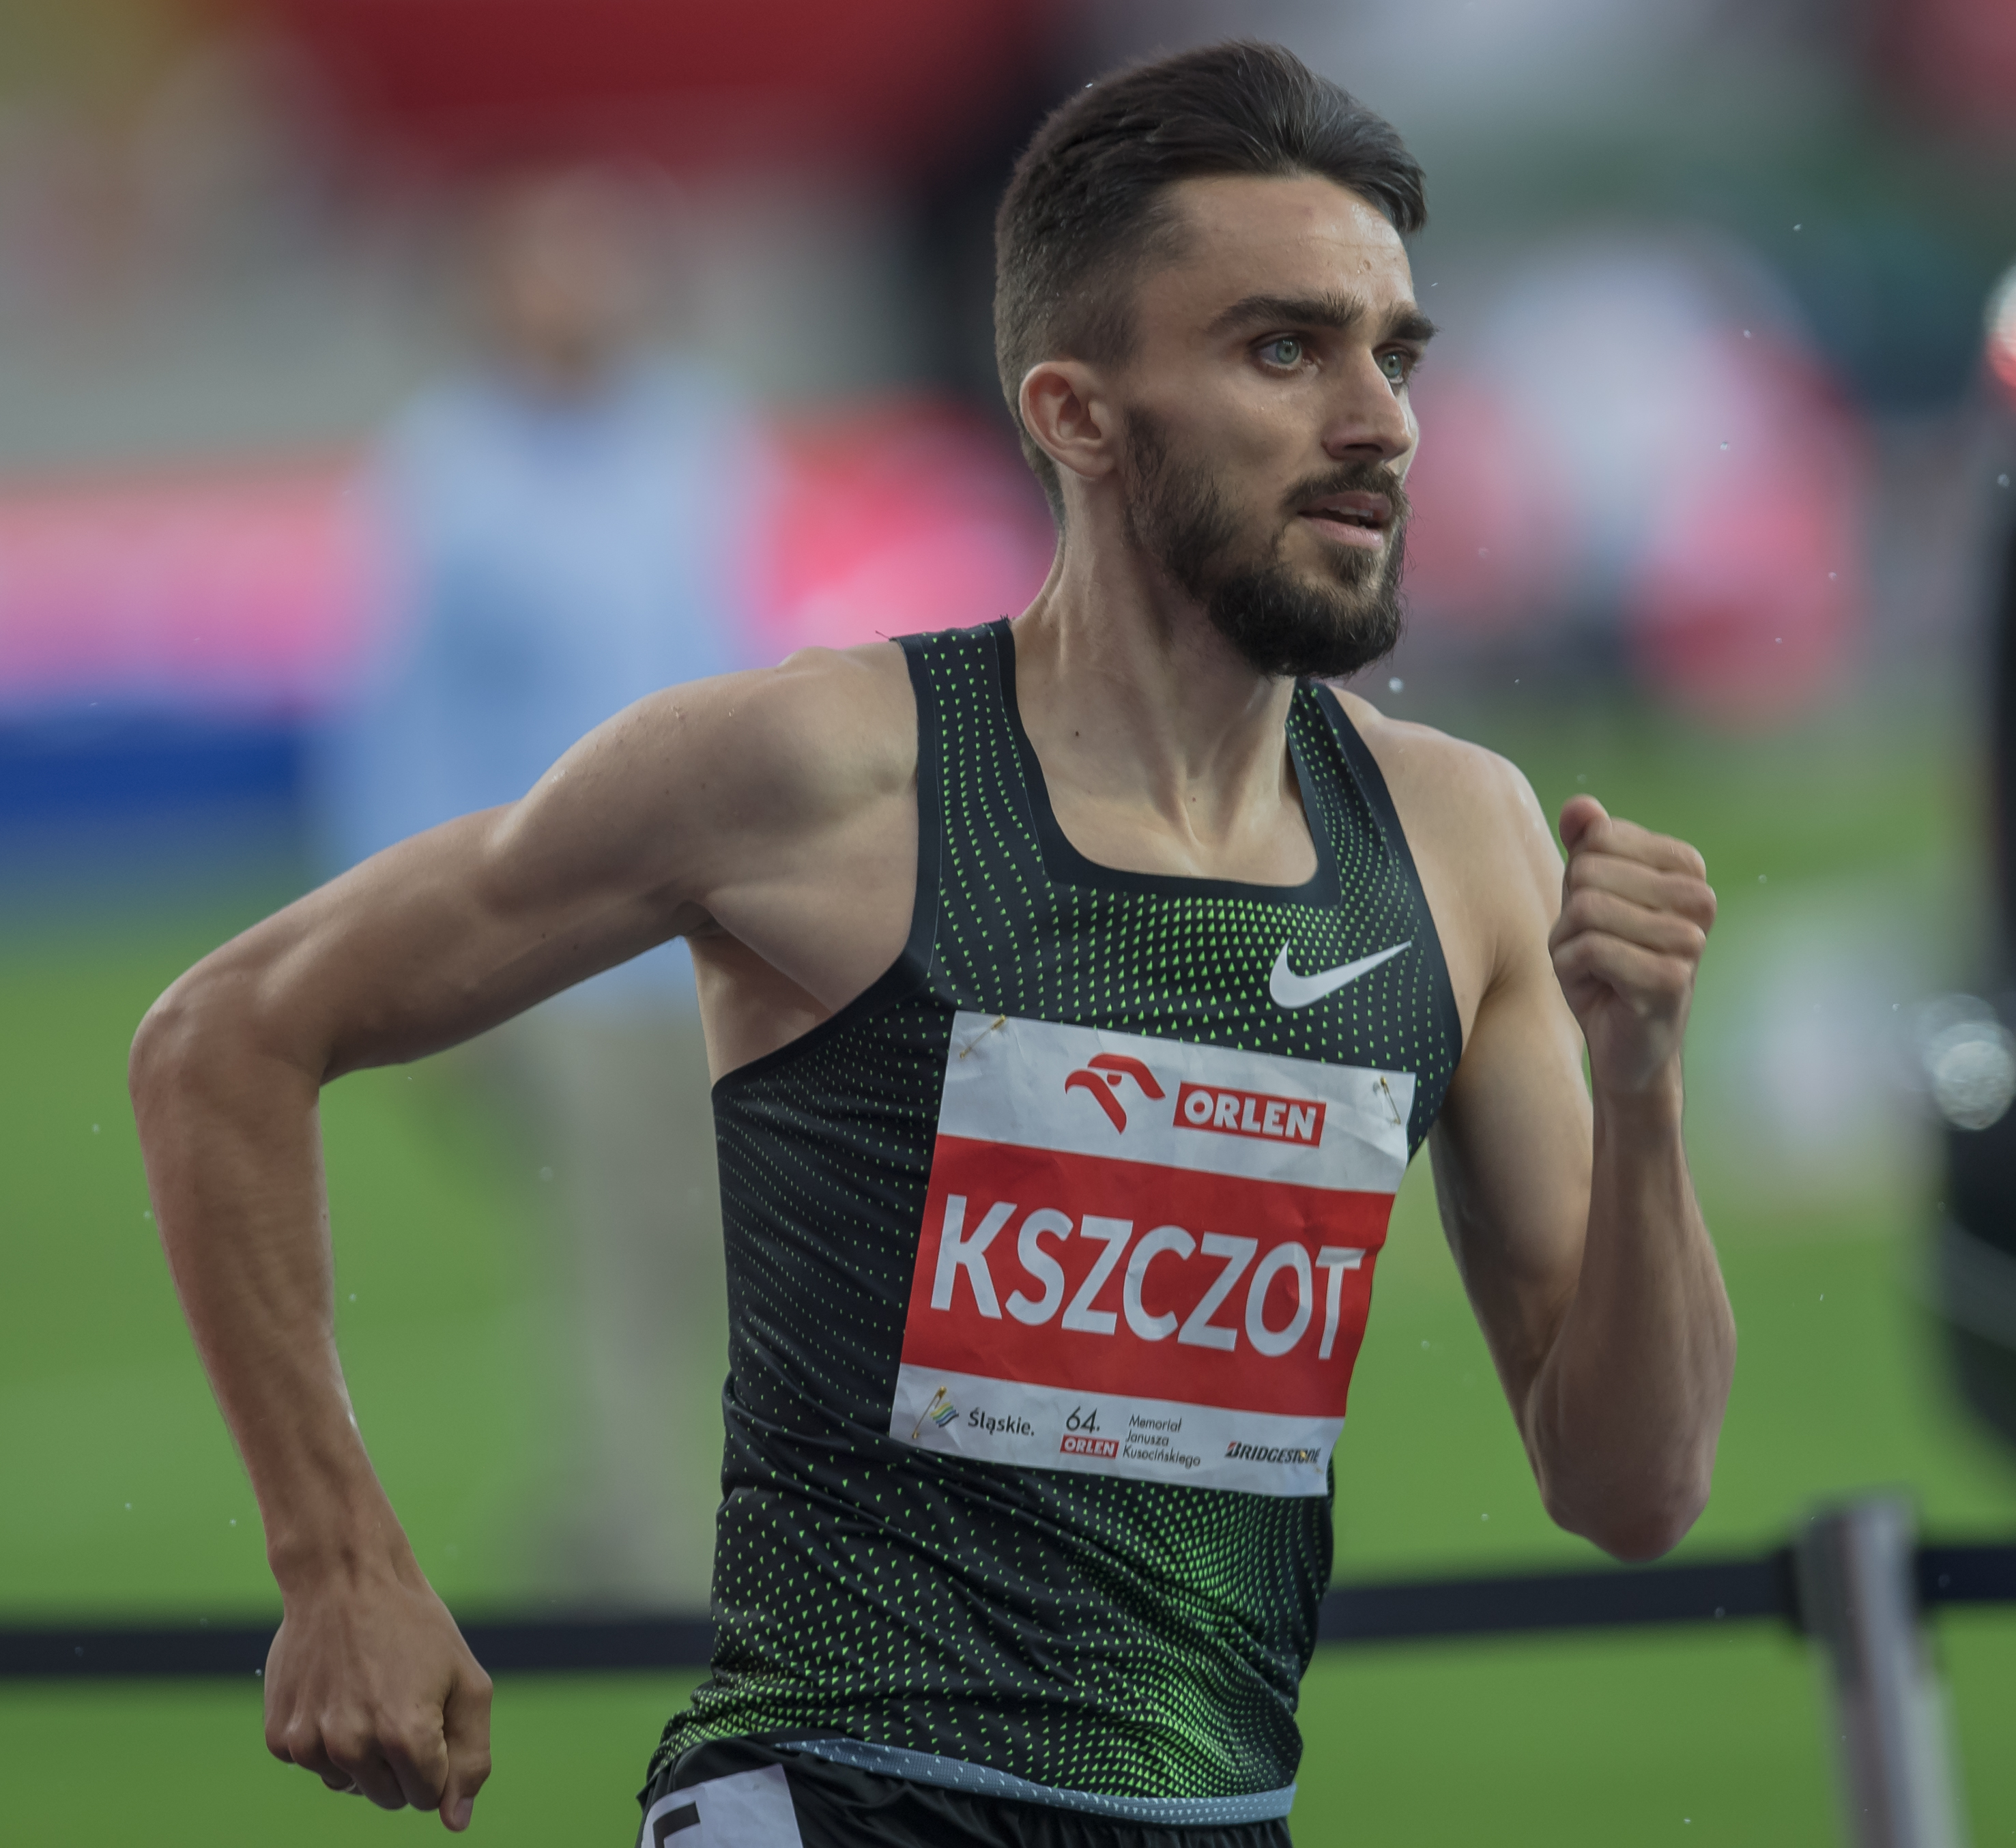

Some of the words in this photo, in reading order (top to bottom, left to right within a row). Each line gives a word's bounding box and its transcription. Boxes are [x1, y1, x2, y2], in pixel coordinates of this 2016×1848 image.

[1183, 1091, 1316, 1140] ORLEN
[930, 1194, 1366, 1360] KSZCZOT
[968, 1406, 1035, 1437] Śląskie.
[1066, 1406, 1101, 1434] 64.
[1129, 1413, 1182, 1433] Memoriał
[1064, 1438, 1115, 1456] ORLEN
[1126, 1430, 1170, 1447] Janusza
[1123, 1445, 1201, 1469] Kusocińskiego
